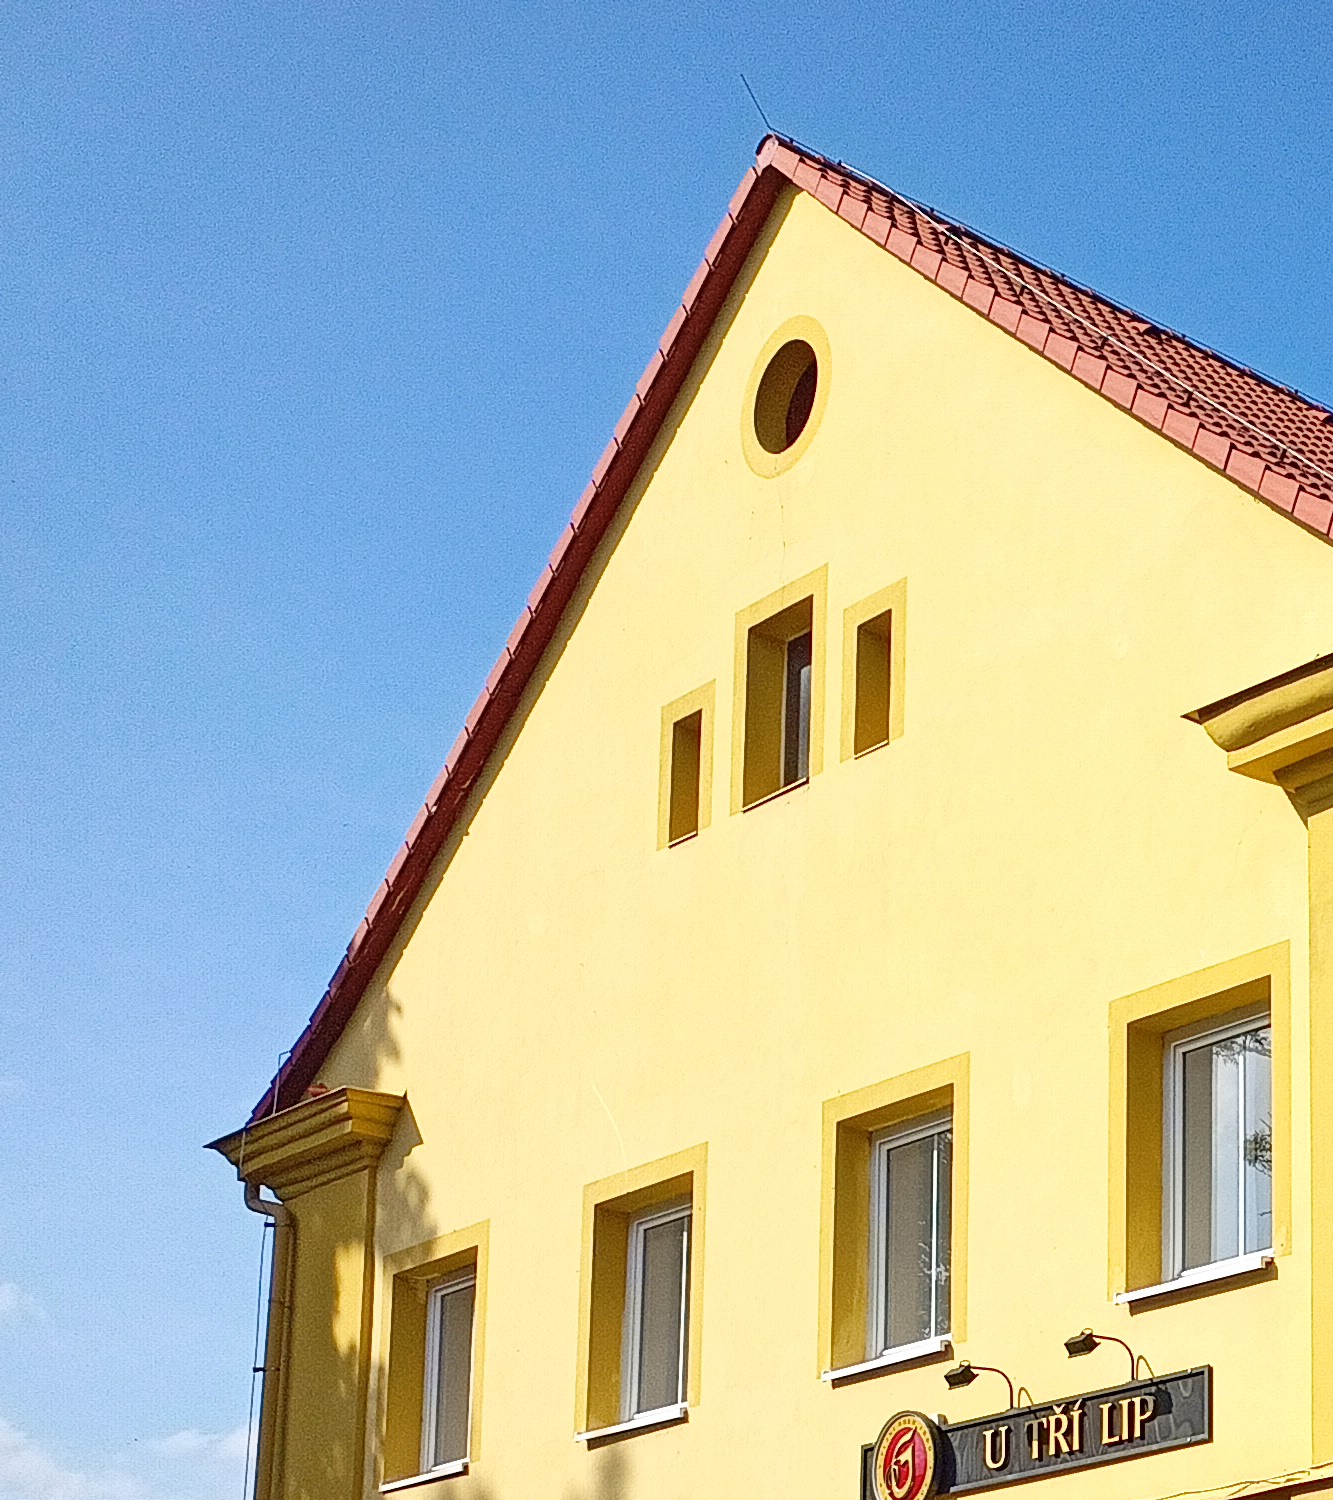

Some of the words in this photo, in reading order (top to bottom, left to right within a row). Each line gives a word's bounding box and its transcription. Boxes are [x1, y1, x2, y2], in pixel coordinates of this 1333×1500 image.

[983, 1426, 1008, 1469] U
[1024, 1399, 1083, 1459] TŘÍ
[1099, 1395, 1155, 1445] LIP
